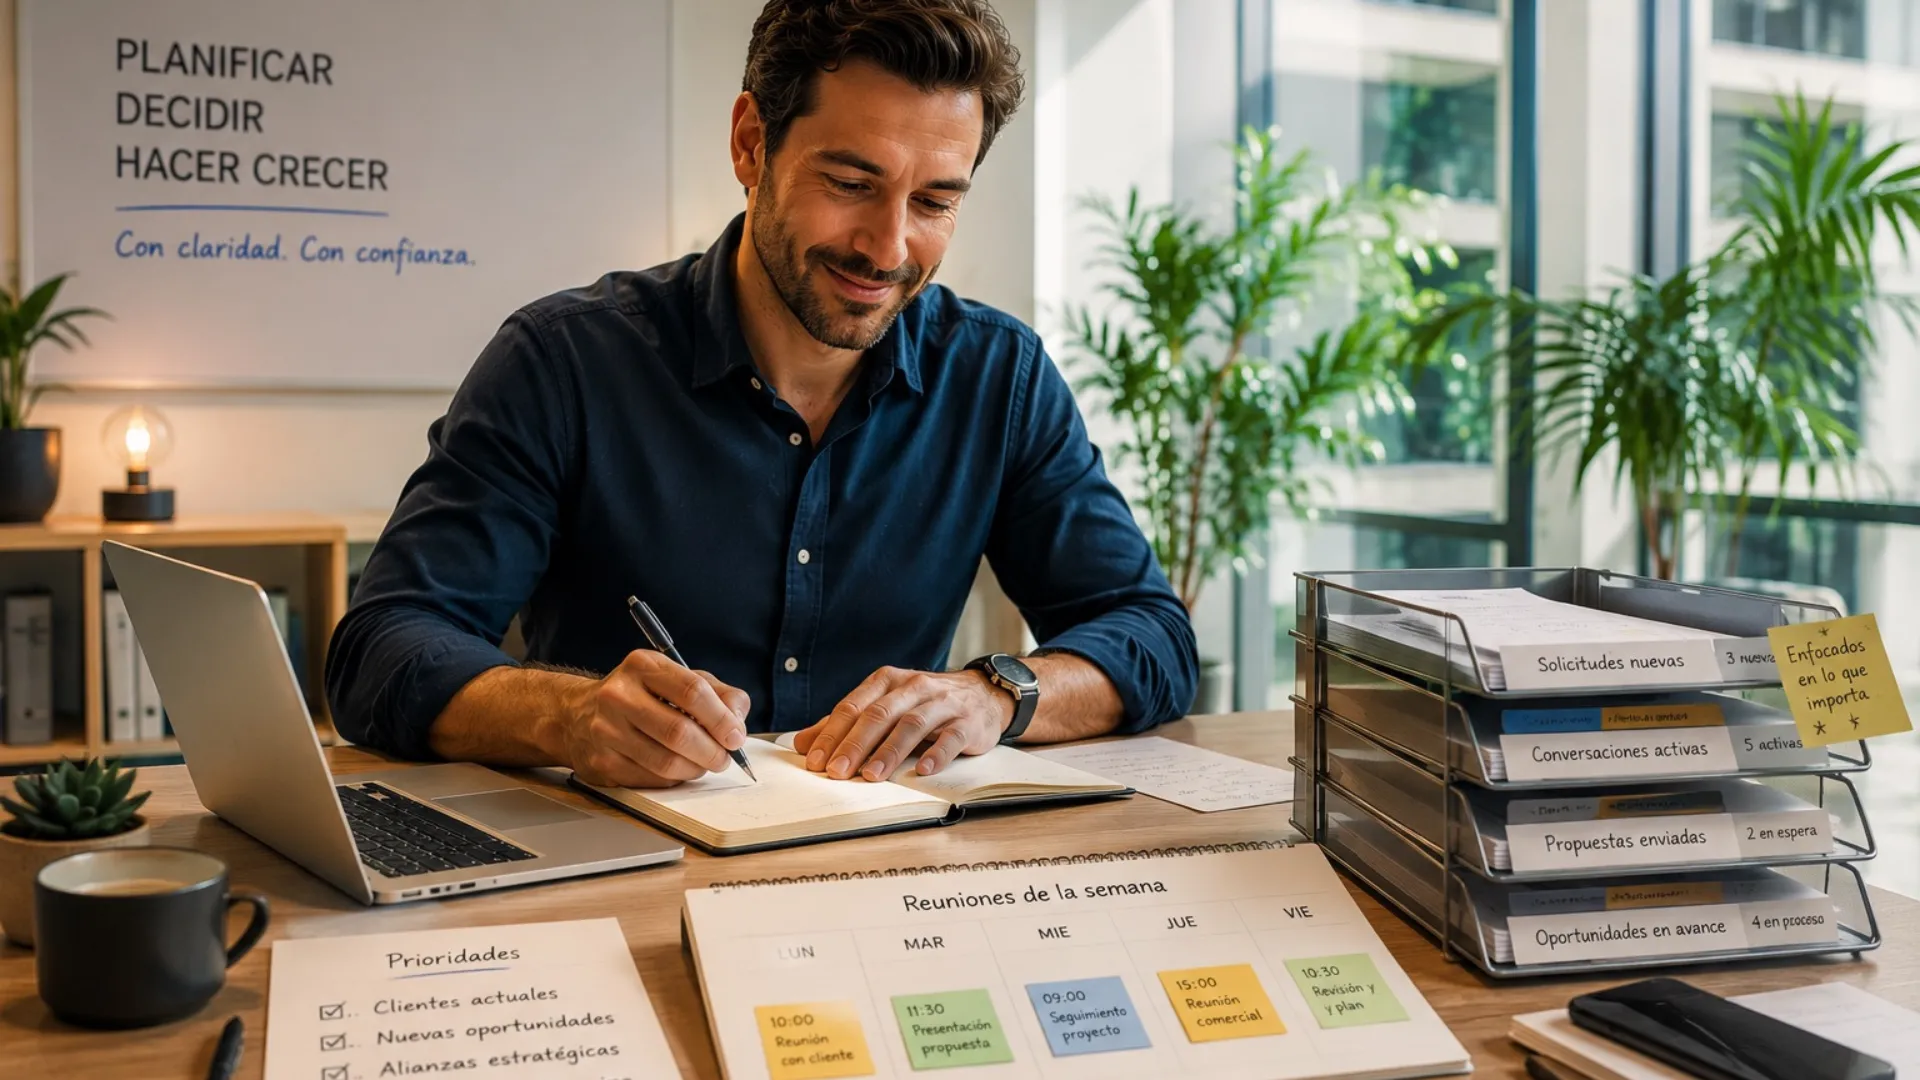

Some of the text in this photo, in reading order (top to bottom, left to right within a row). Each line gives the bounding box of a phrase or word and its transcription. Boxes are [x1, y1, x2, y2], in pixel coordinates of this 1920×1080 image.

[116, 38, 333, 86] PLANIFICAR
[116, 92, 264, 133] DECIDIR
[116, 146, 389, 191] HACER CRECER
[115, 230, 476, 274] Con claridad. Con confianza.
[1725, 651, 1735, 664] 3
[1786, 637, 1866, 665] Enfocados
[1537, 654, 1685, 672] Solicitudes nuevas
[1798, 665, 1868, 687] en lo que
[1806, 688, 1870, 714] importa
[1532, 741, 1709, 762] Conversaciones activas
[1744, 737, 1803, 751] 5 activas
[1545, 828, 1707, 857] Propuestas enviadas
[1746, 826, 1818, 841] 2 en espera
[903, 880, 1168, 912] Reuniones de la semana
[1751, 915, 1761, 929] 4
[1764, 919, 1780, 929] en
[778, 905, 1313, 961] LUN MAR MIE JUE VIE
[1535, 922, 1727, 950] Oportunidades en avance
[385, 946, 521, 970] Prioridades
[1301, 965, 1340, 979] 10:30
[1176, 977, 1217, 991] 15:00
[1312, 983, 1375, 997] Revisión y
[373, 987, 558, 1016] Clientes actuales
[1042, 990, 1086, 1005] 09:00
[1185, 995, 1241, 1010] Reunión
[906, 1003, 945, 1017] 11:30
[1050, 1006, 1127, 1026] Seguimiento
[1197, 1009, 1263, 1027] comercial
[1335, 1001, 1365, 1016] plan
[376, 1012, 615, 1046] Nuevas oportunidades
[770, 1014, 814, 1028] 10:00
[912, 1019, 992, 1037] Presentación
[774, 1034, 829, 1048] Reunión
[1062, 1024, 1121, 1046] proyecto
[921, 1037, 991, 1059] propuesta
[379, 1043, 621, 1079] Alianzas estratégicas
[781, 1050, 855, 1067] con cliente
